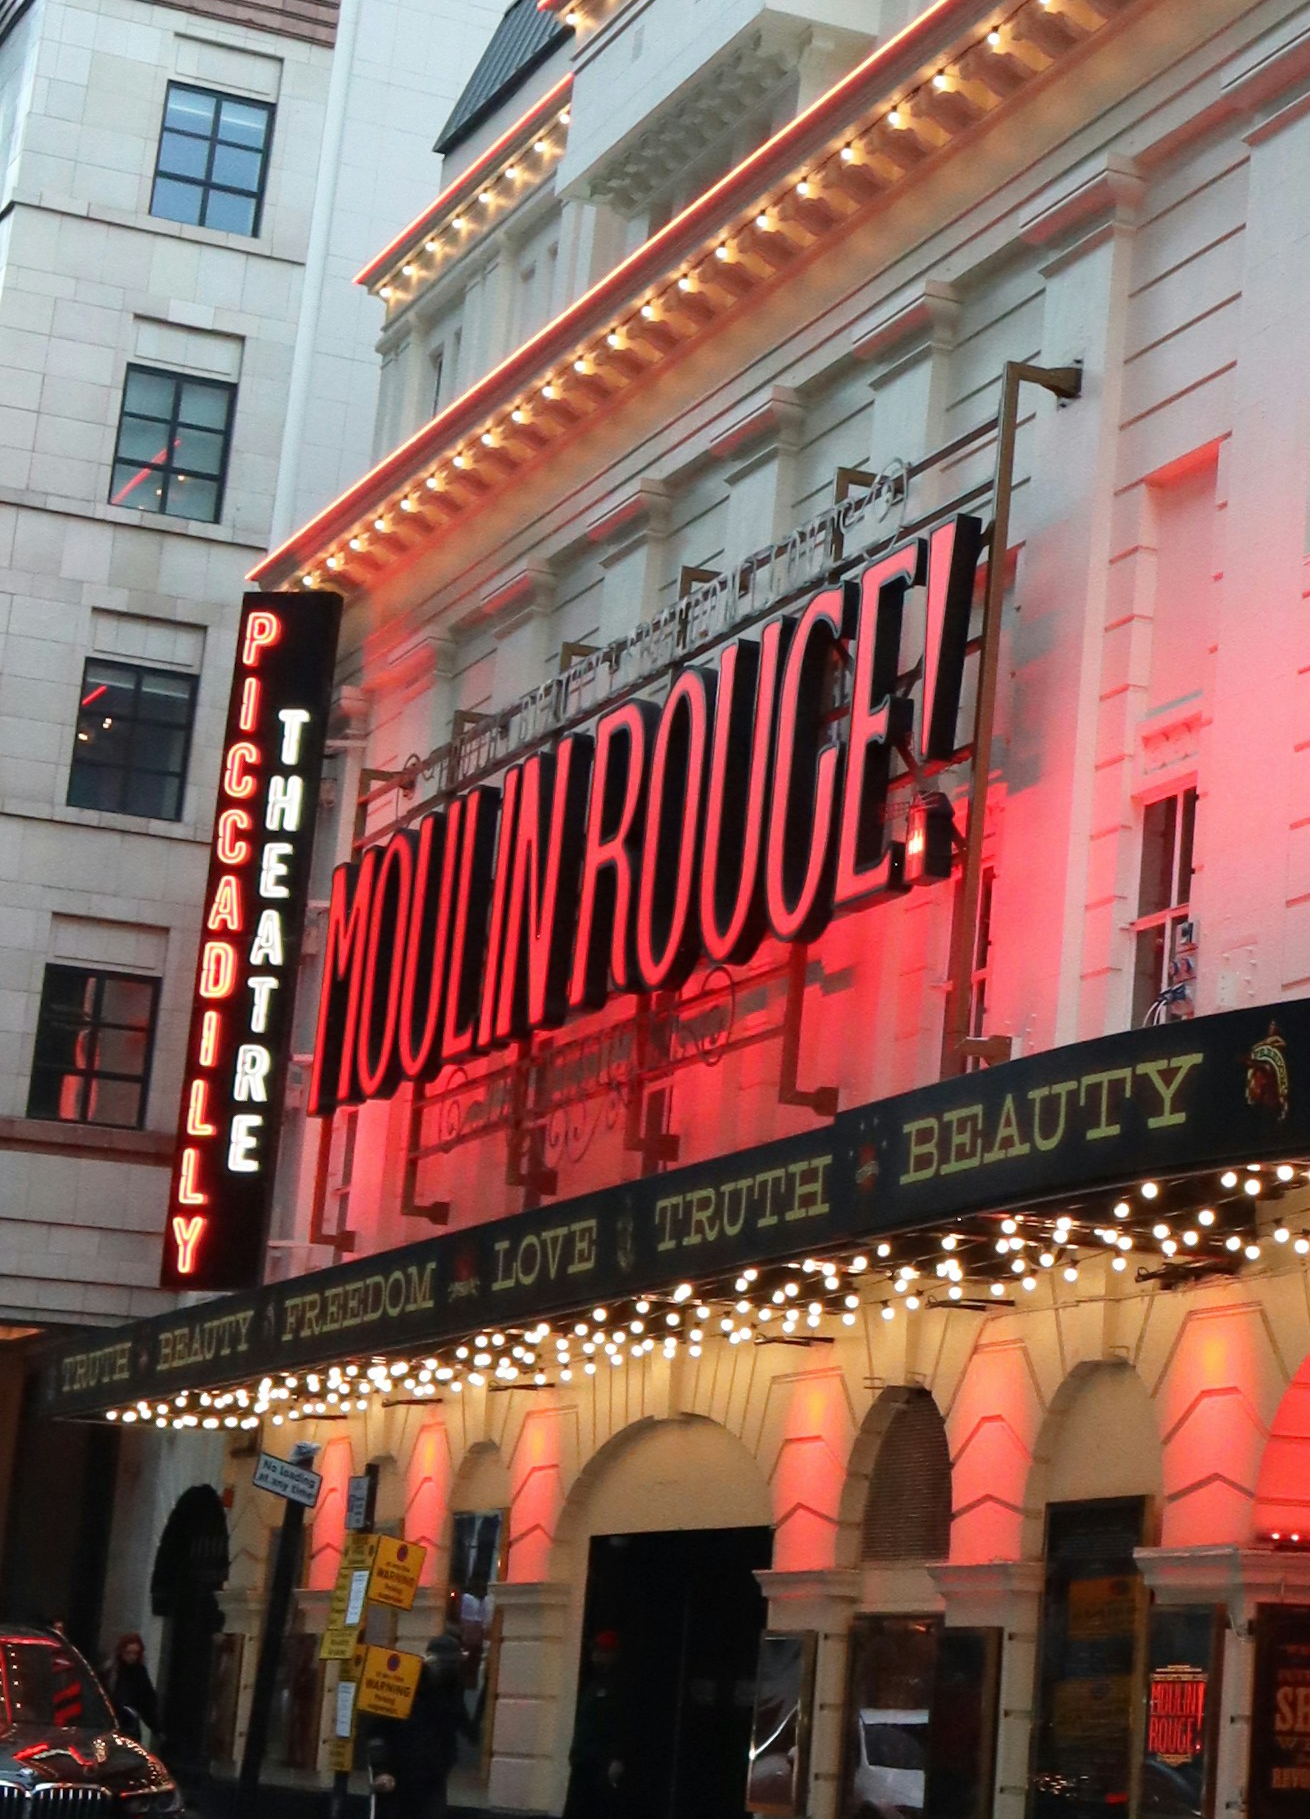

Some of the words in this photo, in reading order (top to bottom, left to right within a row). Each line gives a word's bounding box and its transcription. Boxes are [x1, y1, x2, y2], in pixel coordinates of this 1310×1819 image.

[172, 610, 282, 1274] PICCADILLY
[227, 708, 310, 1173] THEATRE
[309, 731, 582, 1116] MOULIN
[61, 1341, 132, 1391] TRUTH
[156, 1310, 254, 1372] BEAUTY
[281, 1261, 436, 1341] FREEDOM
[492, 1218, 599, 1291] LOVE
[655, 1155, 832, 1252] TRUTH
[899, 1052, 1204, 1185] BEAUTY
[366, 1678, 411, 1698] WARNING
